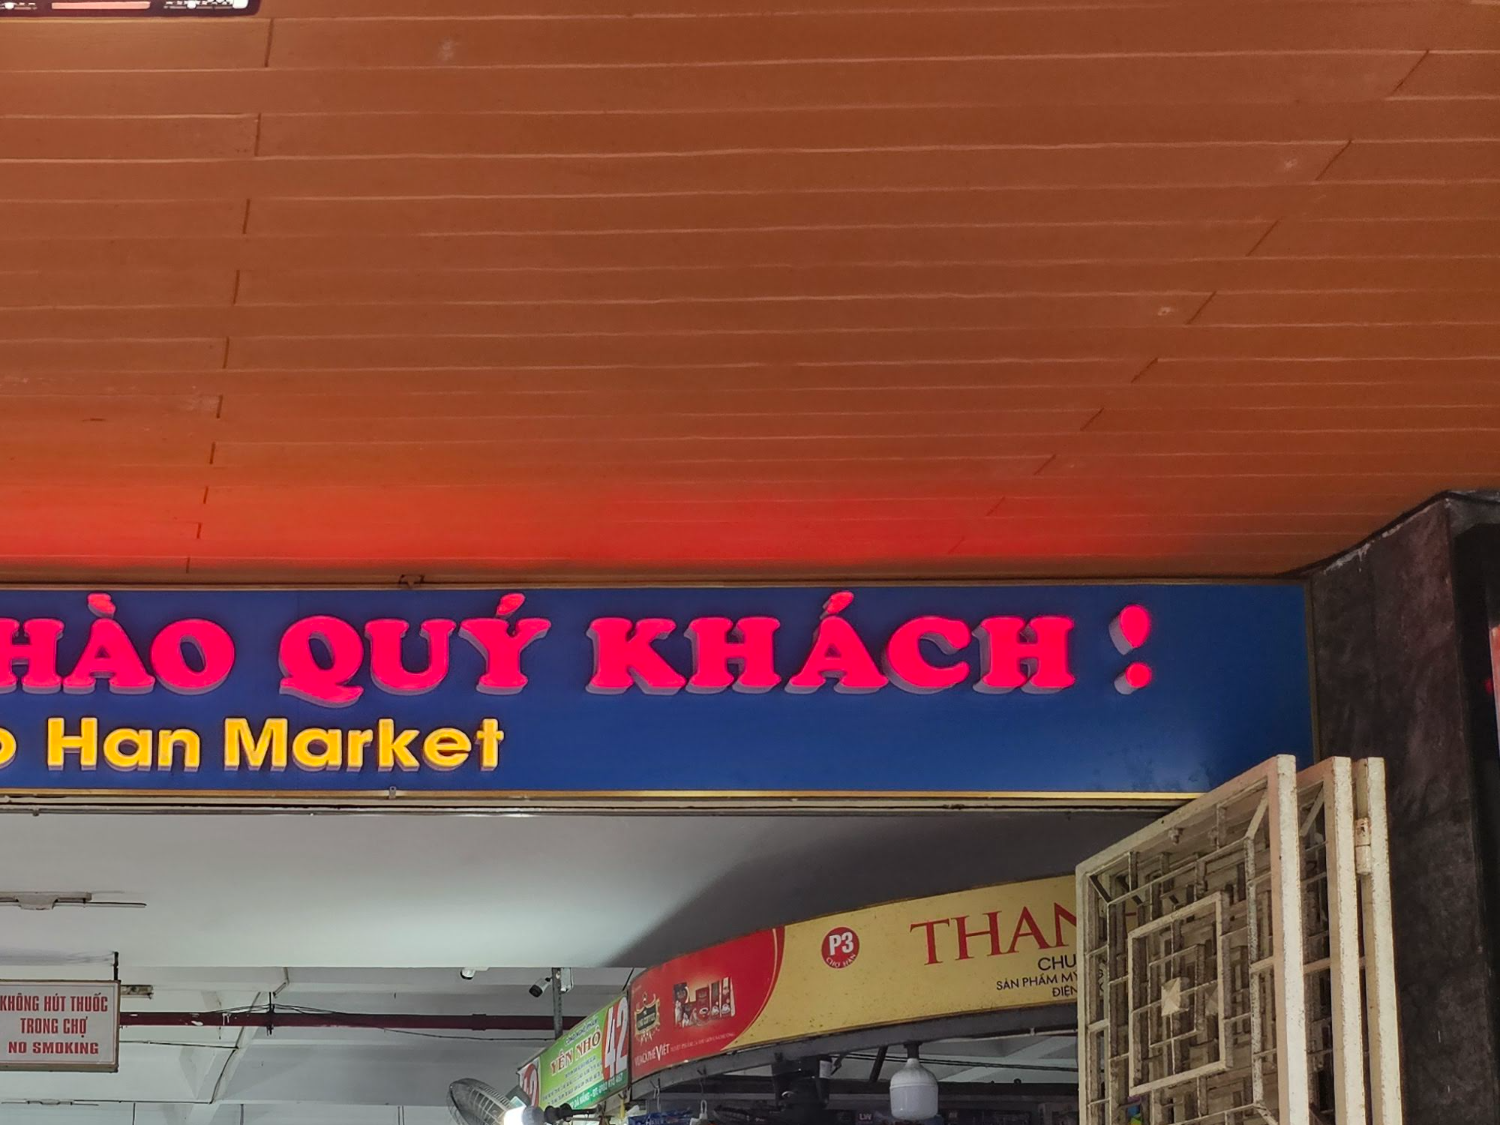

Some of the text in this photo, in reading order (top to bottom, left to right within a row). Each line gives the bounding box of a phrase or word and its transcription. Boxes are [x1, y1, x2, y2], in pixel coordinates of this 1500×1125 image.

[278, 592, 550, 707] QUÝ
[586, 591, 1074, 694] KHÁCH
[47, 716, 200, 771] Han
[223, 717, 504, 772] Market
[829, 931, 854, 956] P3
[0, 992, 108, 1012] KHÔNG HÚT THUỐC
[20, 1016, 88, 1038] TRONG CHỢ
[605, 996, 628, 1080] 42
[8, 1041, 99, 1054] NO SMOKING
